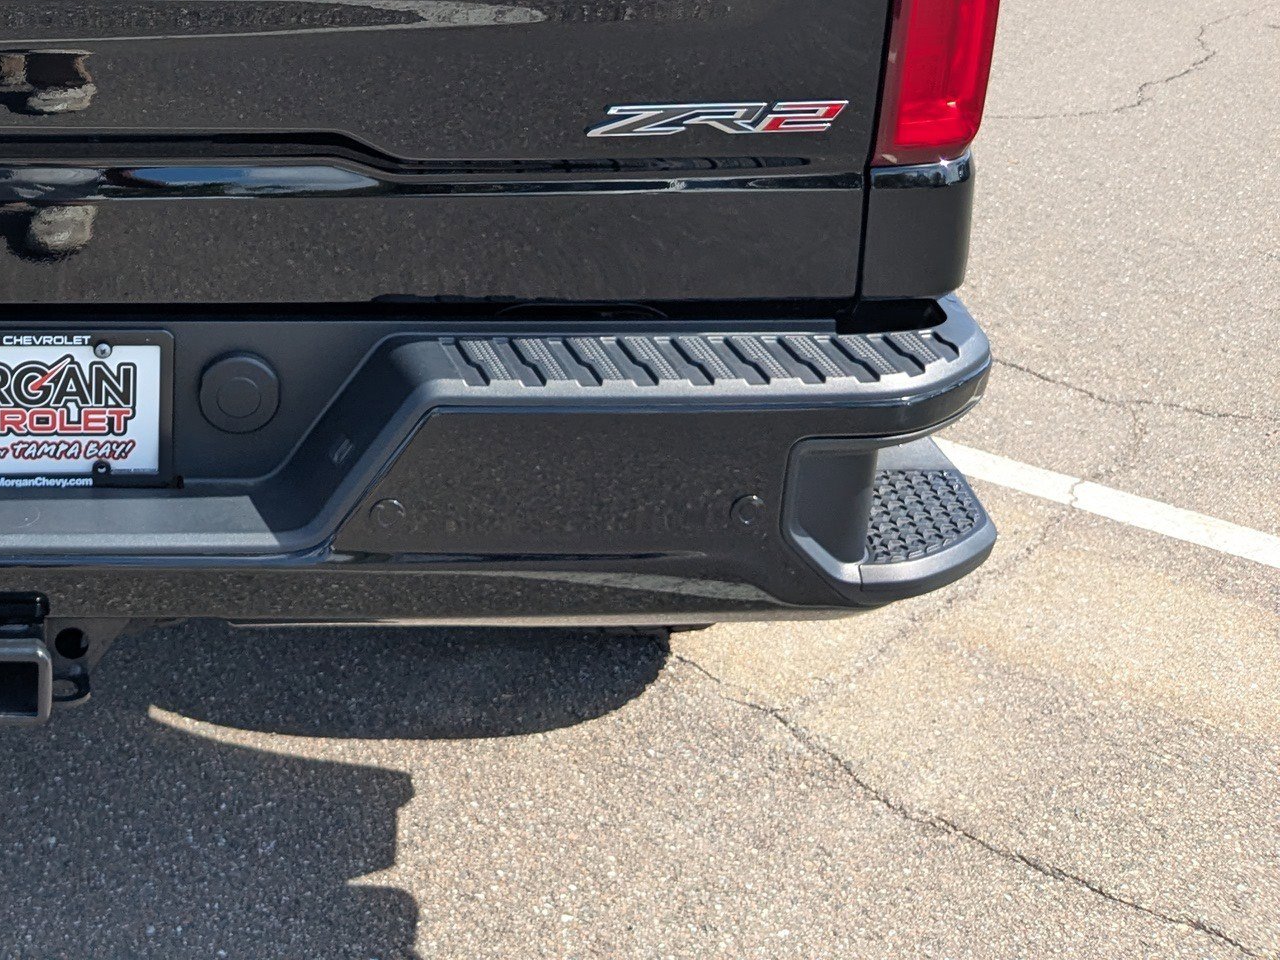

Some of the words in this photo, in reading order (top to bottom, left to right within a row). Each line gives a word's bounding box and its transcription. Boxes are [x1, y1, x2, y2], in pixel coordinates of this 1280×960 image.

[585, 100, 850, 138] ZR2
[2, 335, 91, 345] CHEVROLET
[10, 440, 81, 460] TAMPA
[83, 439, 136, 460] BAY!
